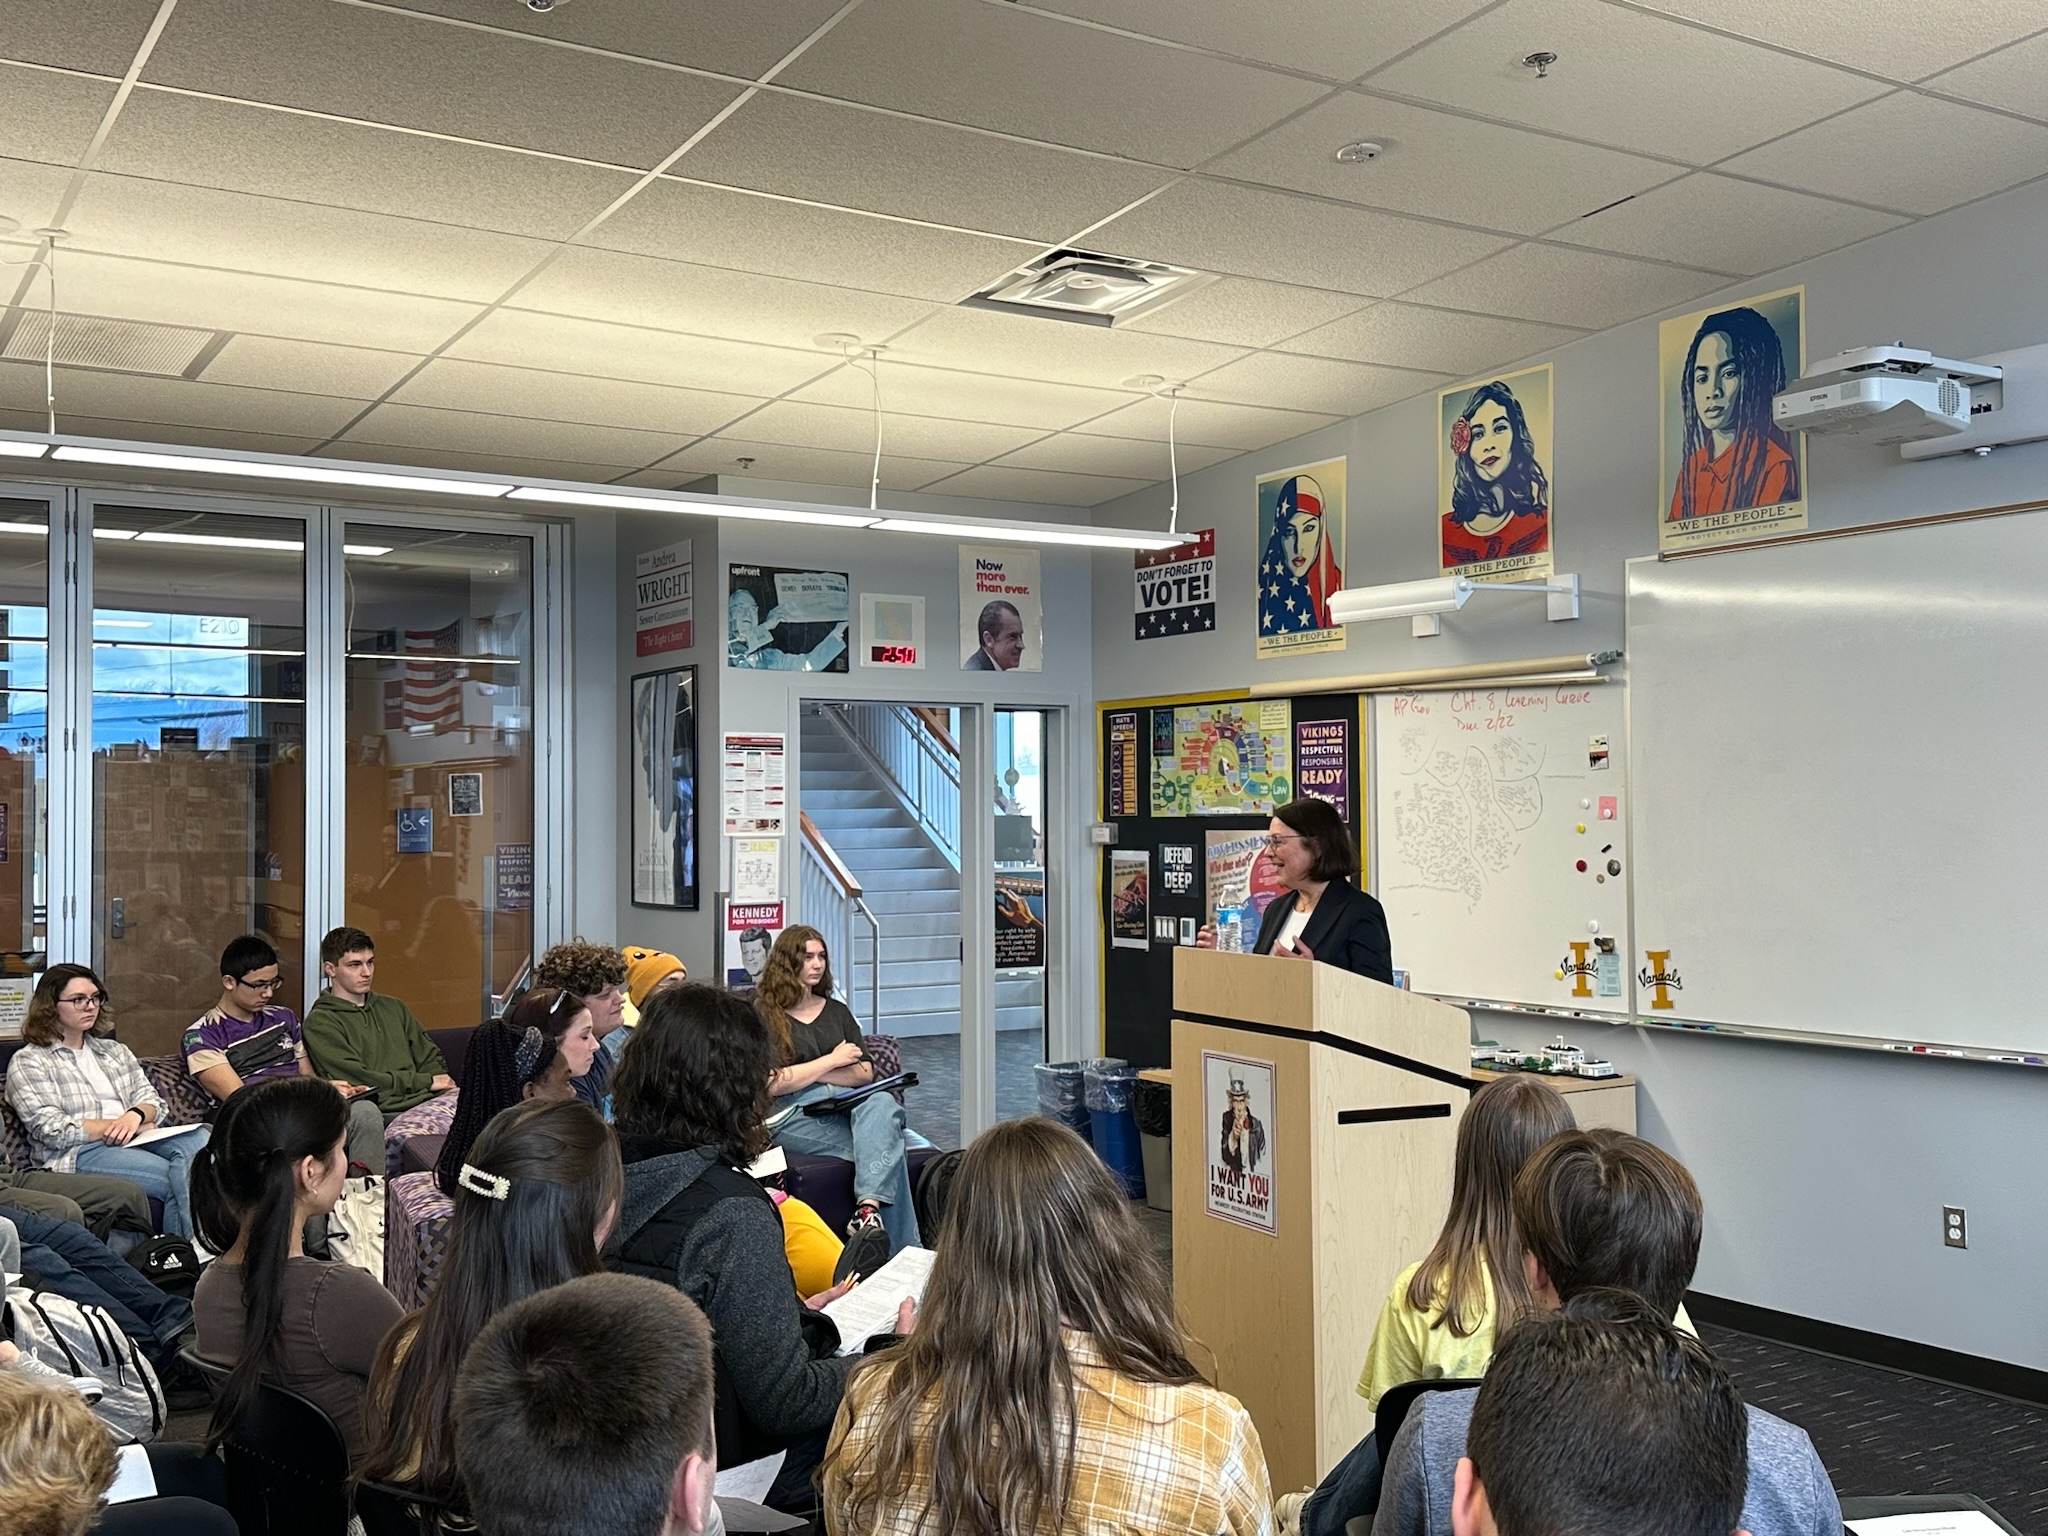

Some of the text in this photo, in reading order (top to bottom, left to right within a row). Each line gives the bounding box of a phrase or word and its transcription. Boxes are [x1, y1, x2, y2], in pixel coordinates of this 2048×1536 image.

[1810, 393, 1828, 402] EPSON
[1678, 506, 1786, 532] WE THE PEOPLE
[1686, 522, 1780, 542] PROTECT EACH OTHER
[651, 551, 677, 569] Andrea
[976, 559, 1004, 571] Now
[1453, 555, 1537, 576] WE THE PEOPLE
[731, 566, 761, 577] upfront
[976, 571, 1006, 582] more
[1136, 560, 1213, 583] DON'T FORGET TO
[637, 571, 691, 605] WRIGHT
[976, 581, 1030, 595] than ever.
[1140, 573, 1210, 609] VOTE!
[1267, 630, 1334, 646] WE THE PEOPLE
[1393, 698, 1408, 716] AP
[1486, 691, 1496, 711] 8
[1453, 709, 1516, 732] Due 2/22
[1301, 725, 1344, 739] VIKINGS
[1301, 745, 1344, 756] RESPECTFUL
[1301, 757, 1344, 767] RESPONSIBLE
[1301, 769, 1344, 785] READY
[1272, 784, 1288, 795] Law
[1163, 846, 1193, 865] DEFEND
[1172, 864, 1185, 872] THE
[1164, 871, 1193, 890] DEEP
[732, 906, 779, 919] KENNEDY
[746, 917, 779, 925] PRESIDENT
[1004, 927, 1017, 936] right
[1560, 955, 1599, 979] Vandals
[1638, 967, 1683, 990] Vandals
[1211, 1164, 1270, 1198] I WANT YOU
[1211, 1183, 1270, 1213] FOR U.S. ARMY
